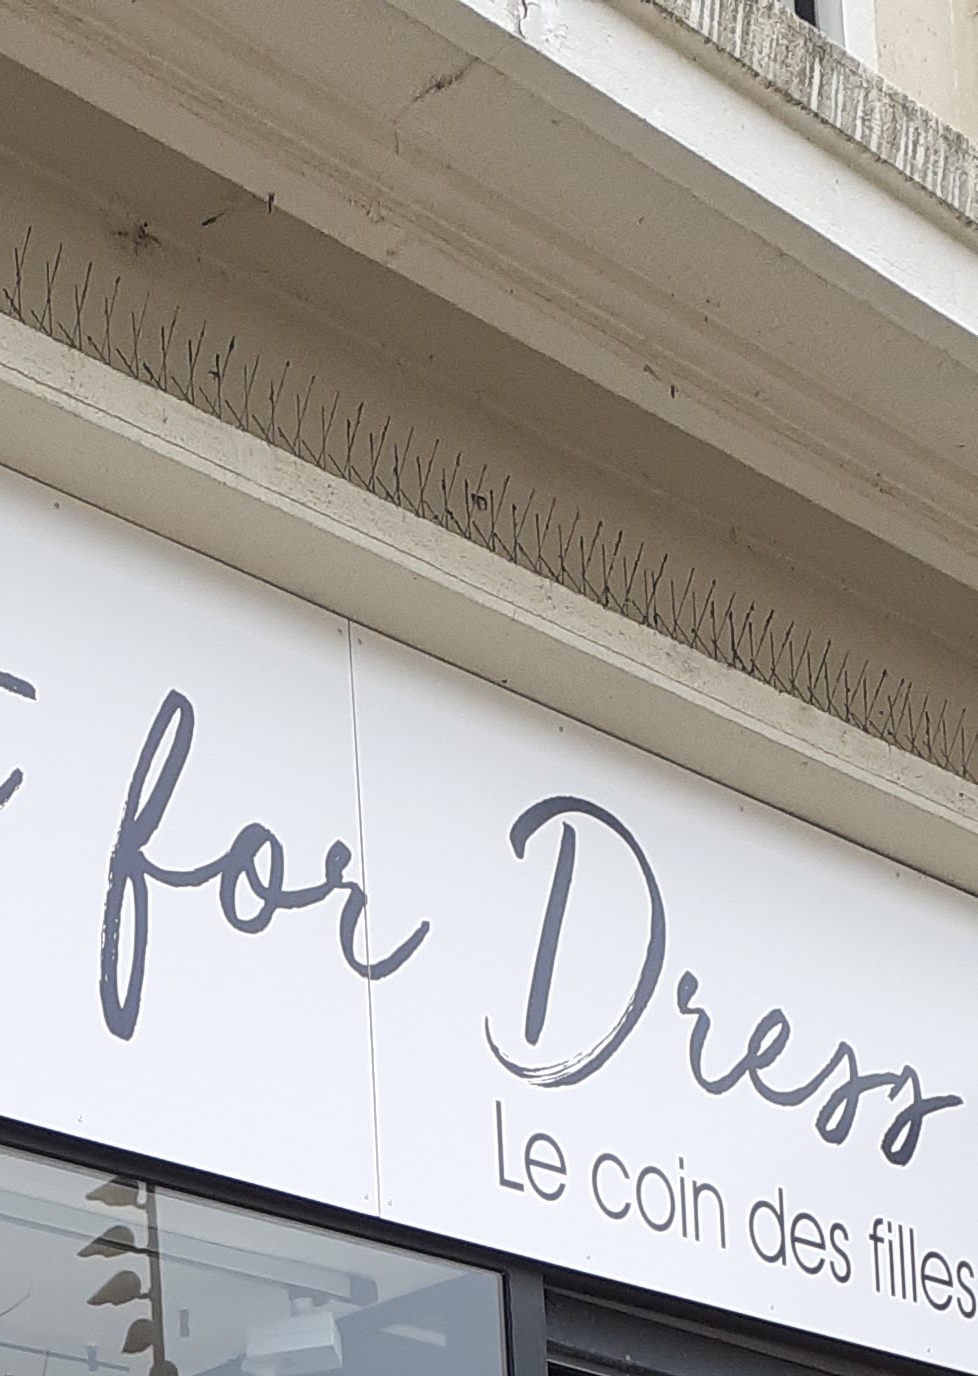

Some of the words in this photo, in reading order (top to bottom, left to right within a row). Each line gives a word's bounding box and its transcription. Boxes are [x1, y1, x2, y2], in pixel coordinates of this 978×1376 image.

[99, 689, 431, 1041] for
[485, 795, 962, 1166] Dress
[494, 1099, 568, 1201] Le
[591, 1154, 727, 1250] coin
[748, 1187, 853, 1284] des
[869, 1215, 977, 1320] filles
